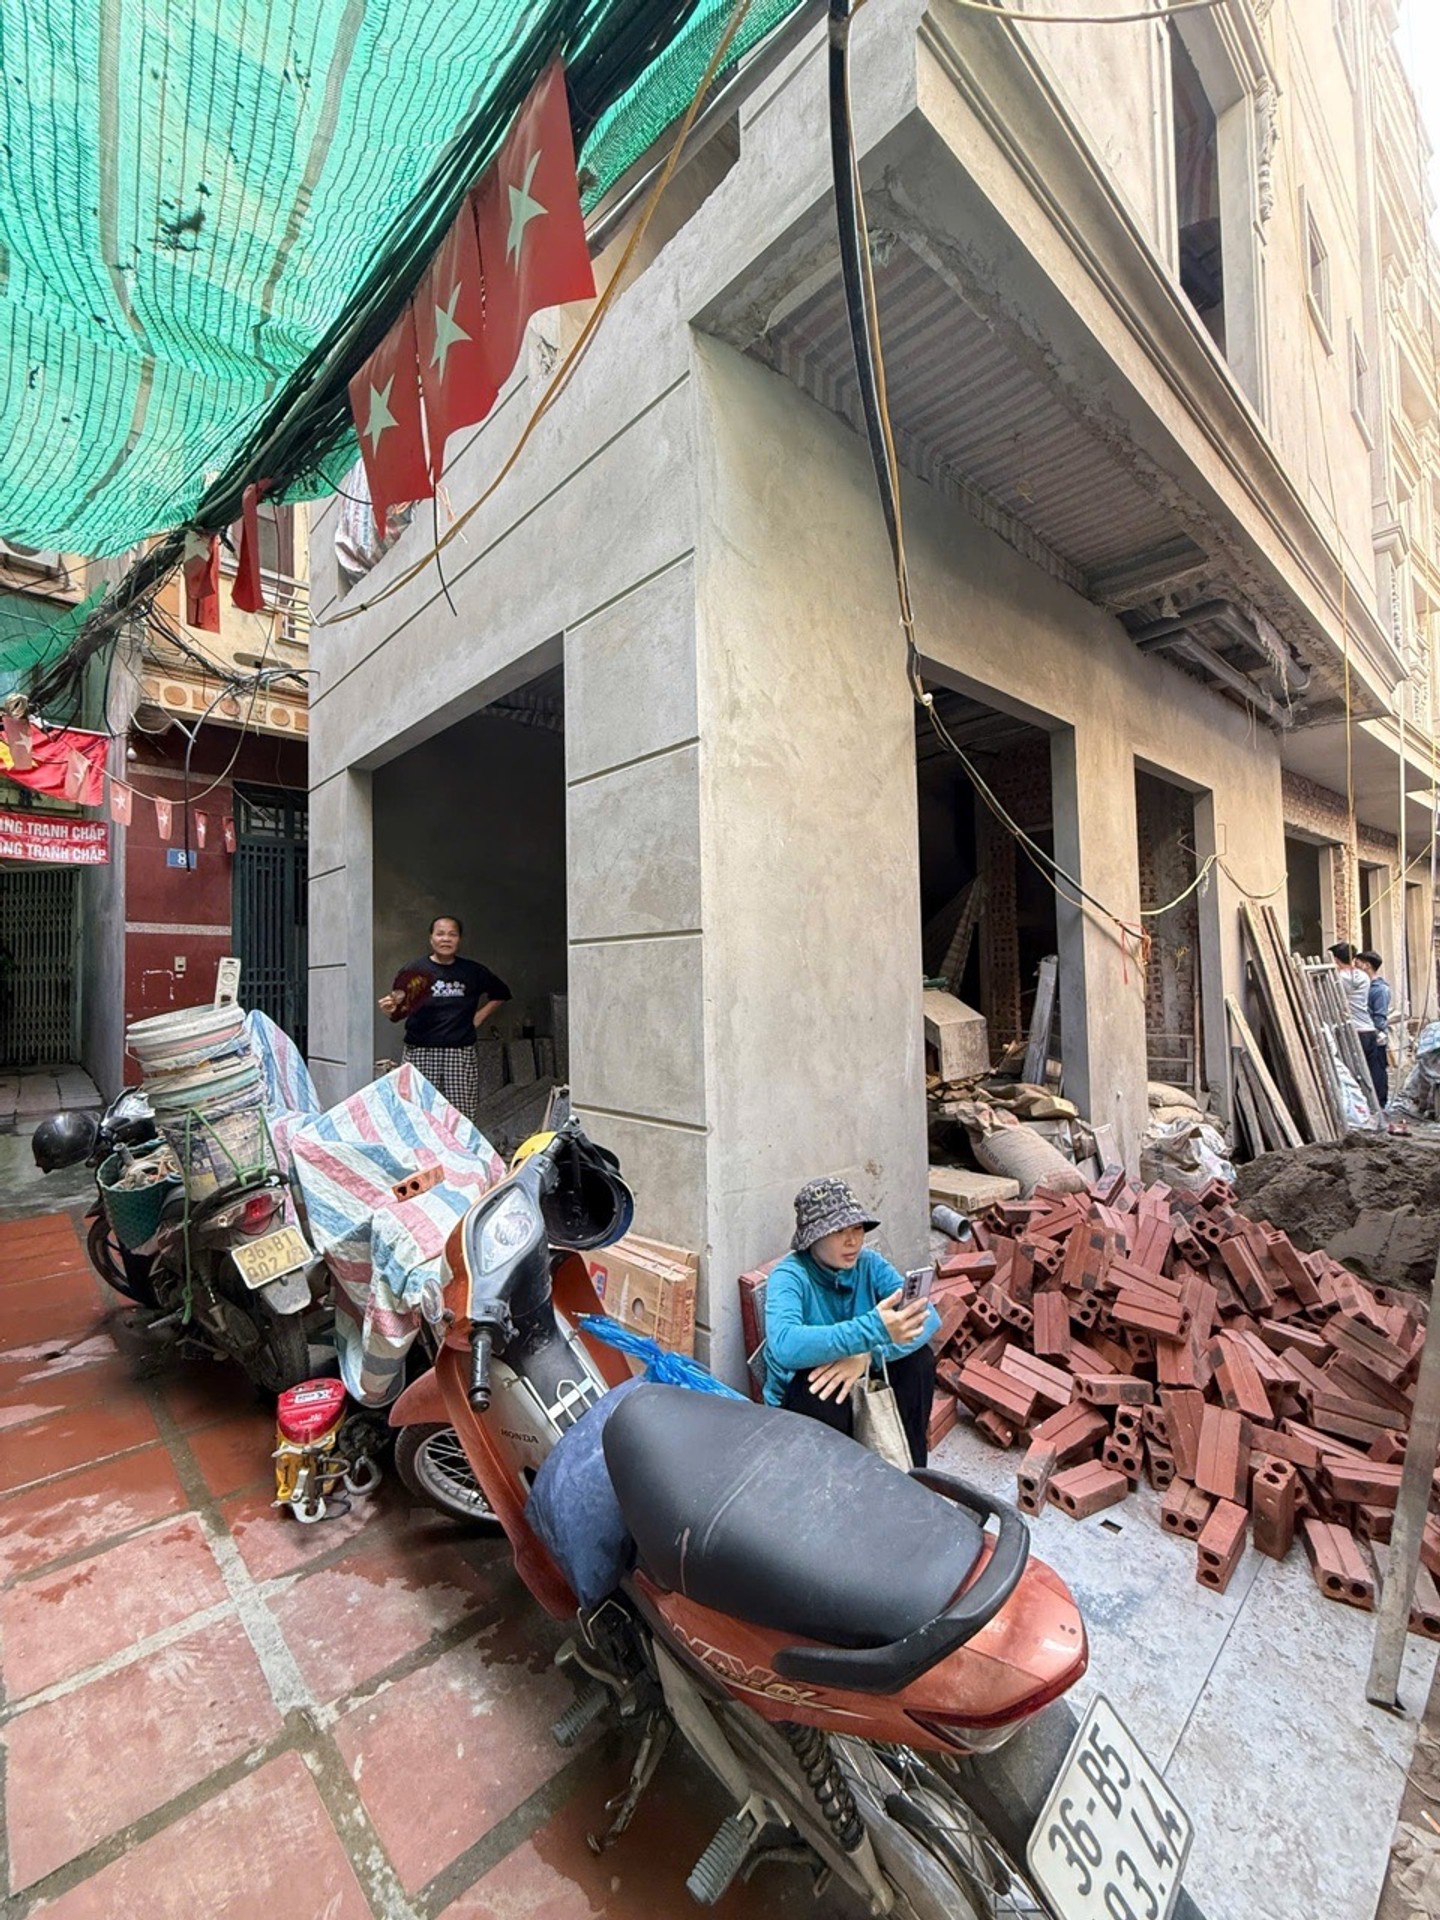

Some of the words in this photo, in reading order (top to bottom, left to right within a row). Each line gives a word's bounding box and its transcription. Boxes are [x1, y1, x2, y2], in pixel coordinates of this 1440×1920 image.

[27, 822, 69, 839] TRANH
[72, 823, 105, 840] CHẤP
[0, 841, 22, 855] NG
[24, 843, 69, 860] TRANH
[177, 851, 187, 865] 8
[501, 1429, 539, 1444] HONDA
[1048, 1722, 1131, 1896] 36-B5
